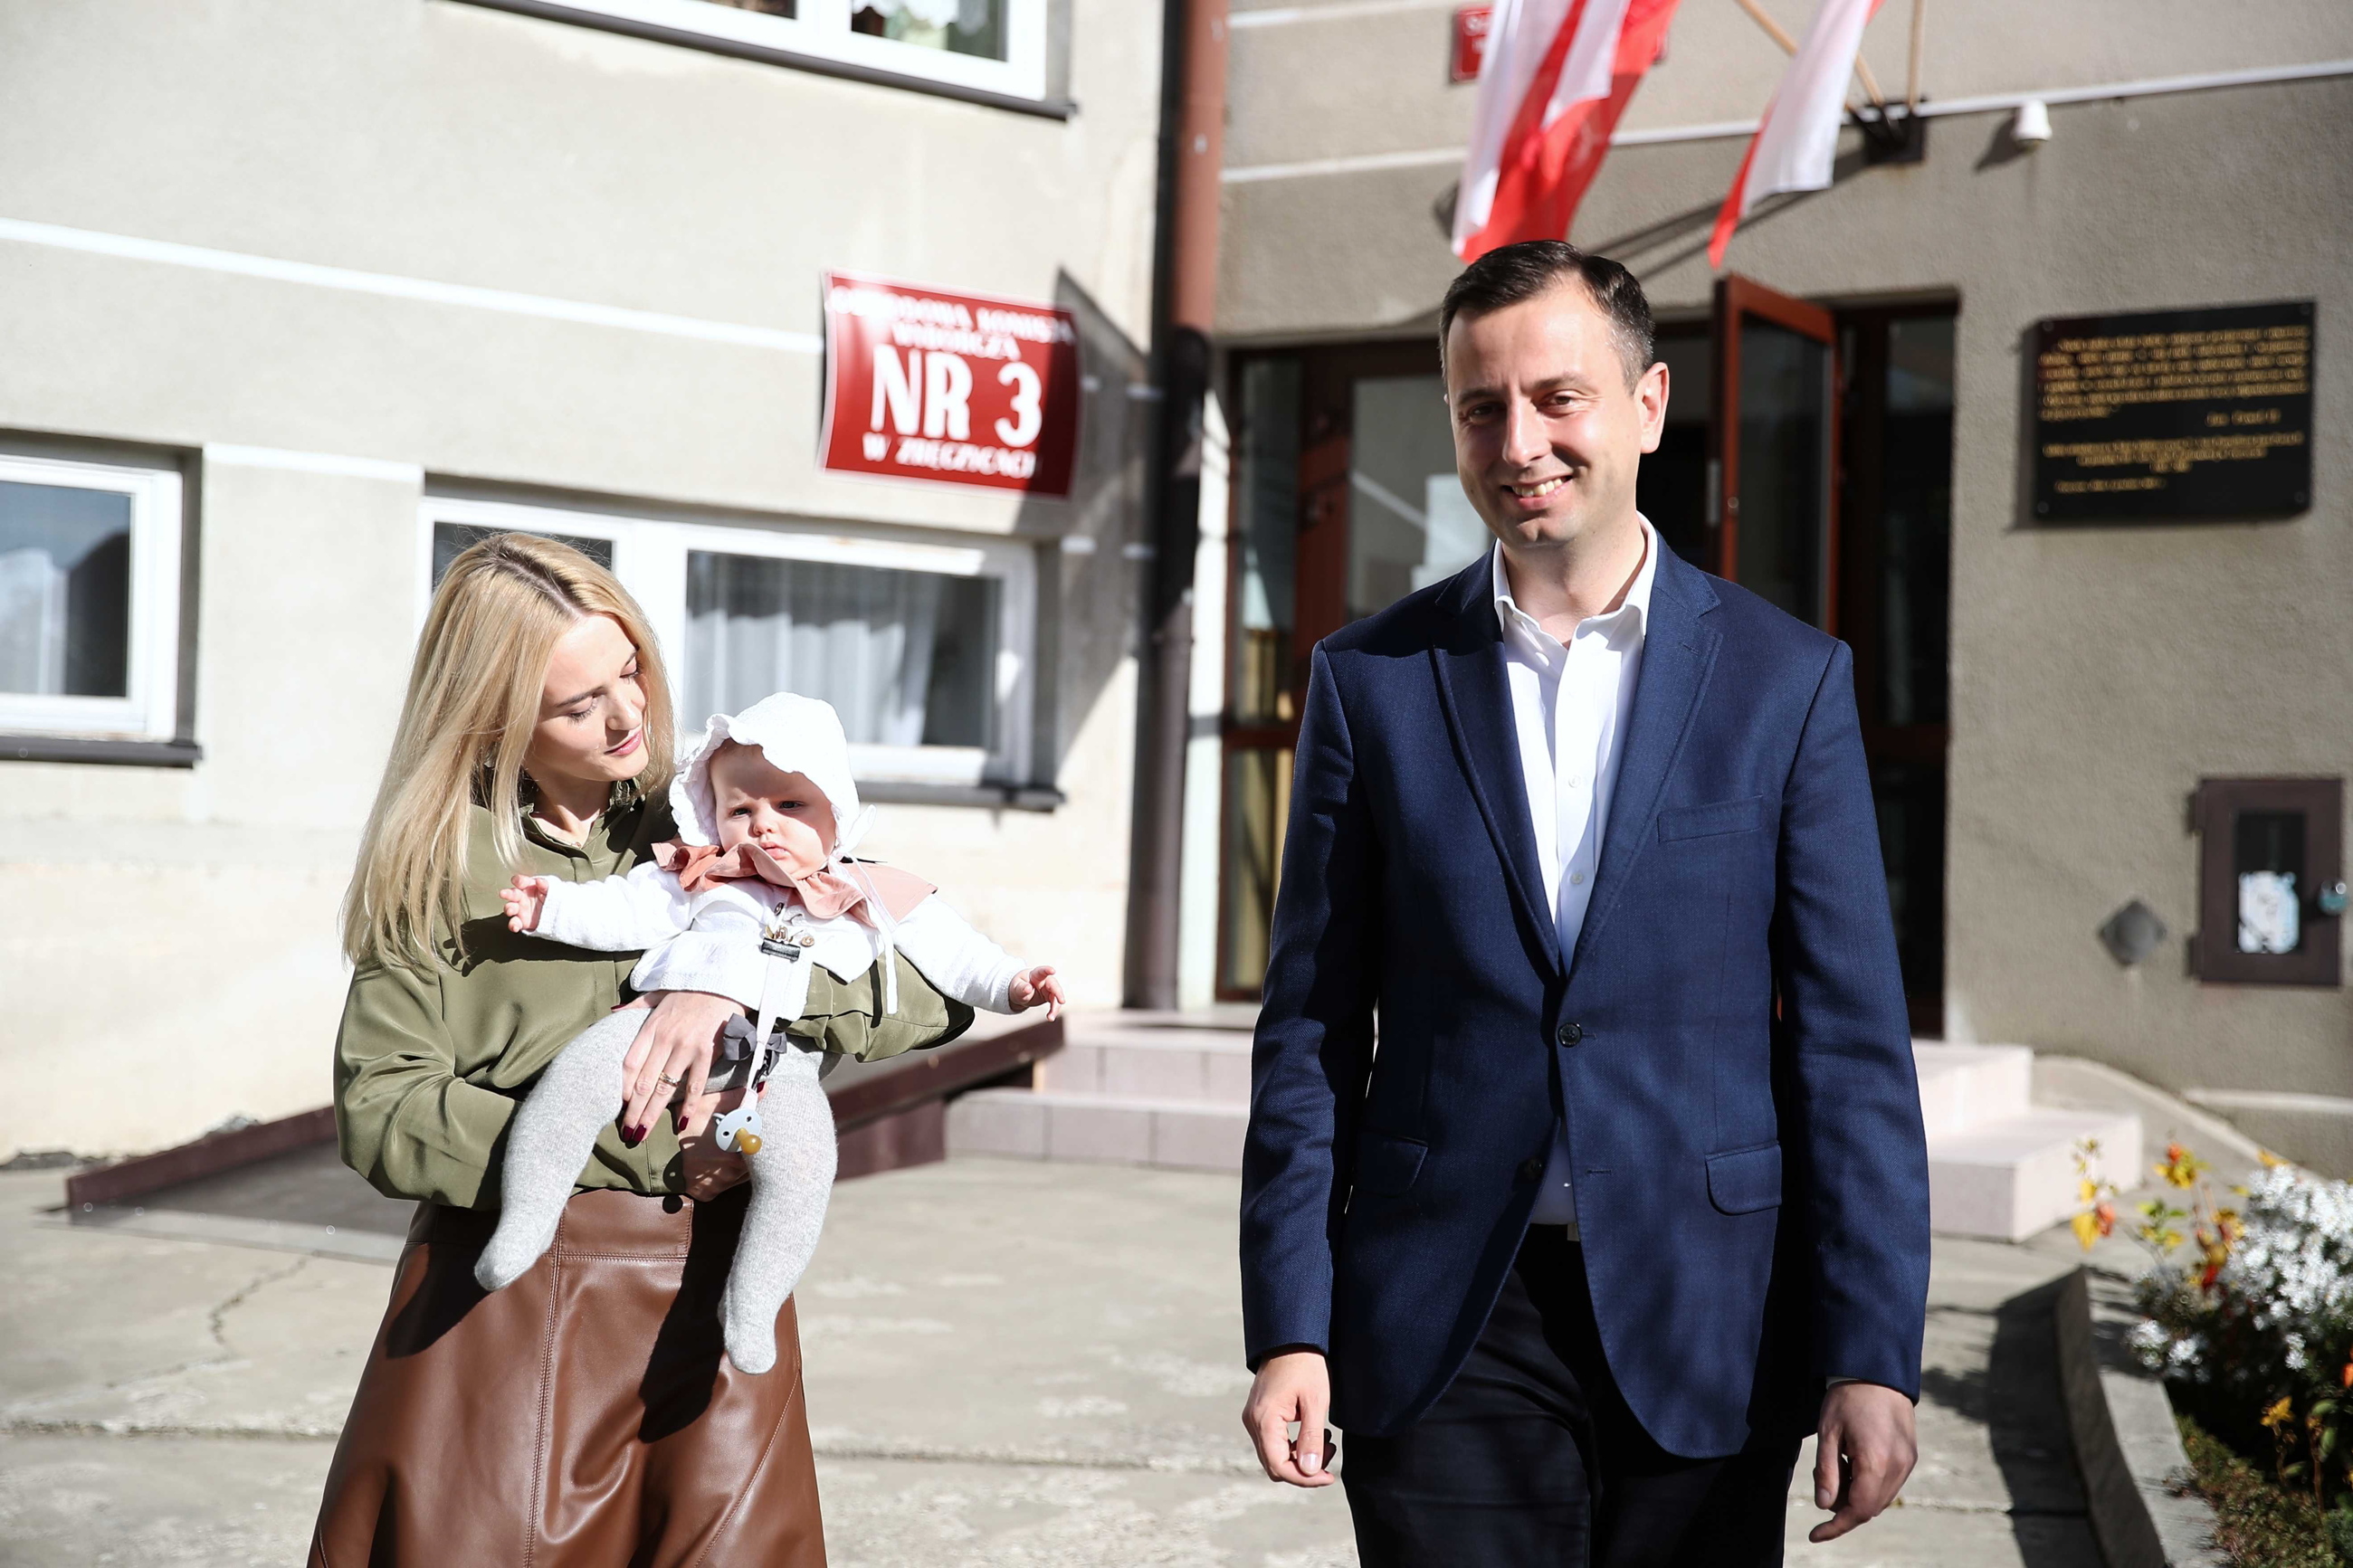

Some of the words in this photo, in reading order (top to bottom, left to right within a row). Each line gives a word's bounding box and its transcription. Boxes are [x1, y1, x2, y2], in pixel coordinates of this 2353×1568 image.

[870, 343, 973, 442] NR
[994, 361, 1043, 447] 3
[862, 431, 891, 462] W
